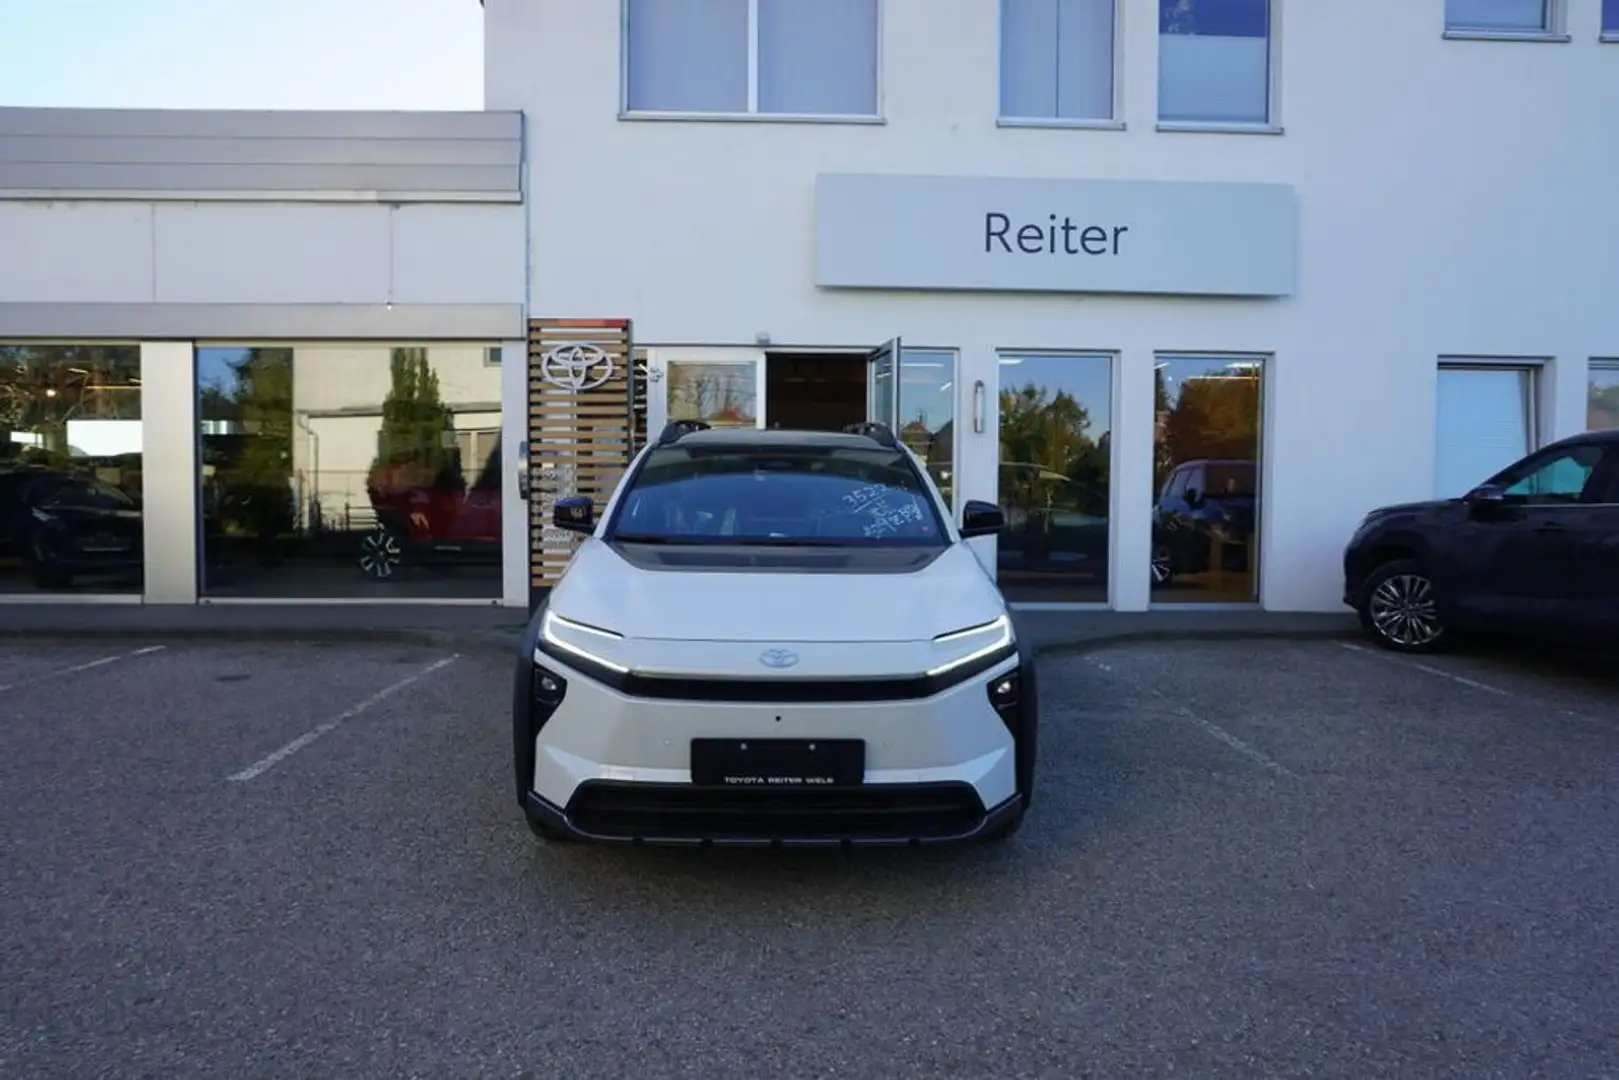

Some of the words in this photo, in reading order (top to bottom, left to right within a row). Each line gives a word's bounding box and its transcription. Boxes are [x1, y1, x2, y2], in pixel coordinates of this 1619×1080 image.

[985, 212, 1129, 255] Reiter
[724, 776, 765, 784] TOYOTA
[768, 776, 802, 784] REITER
